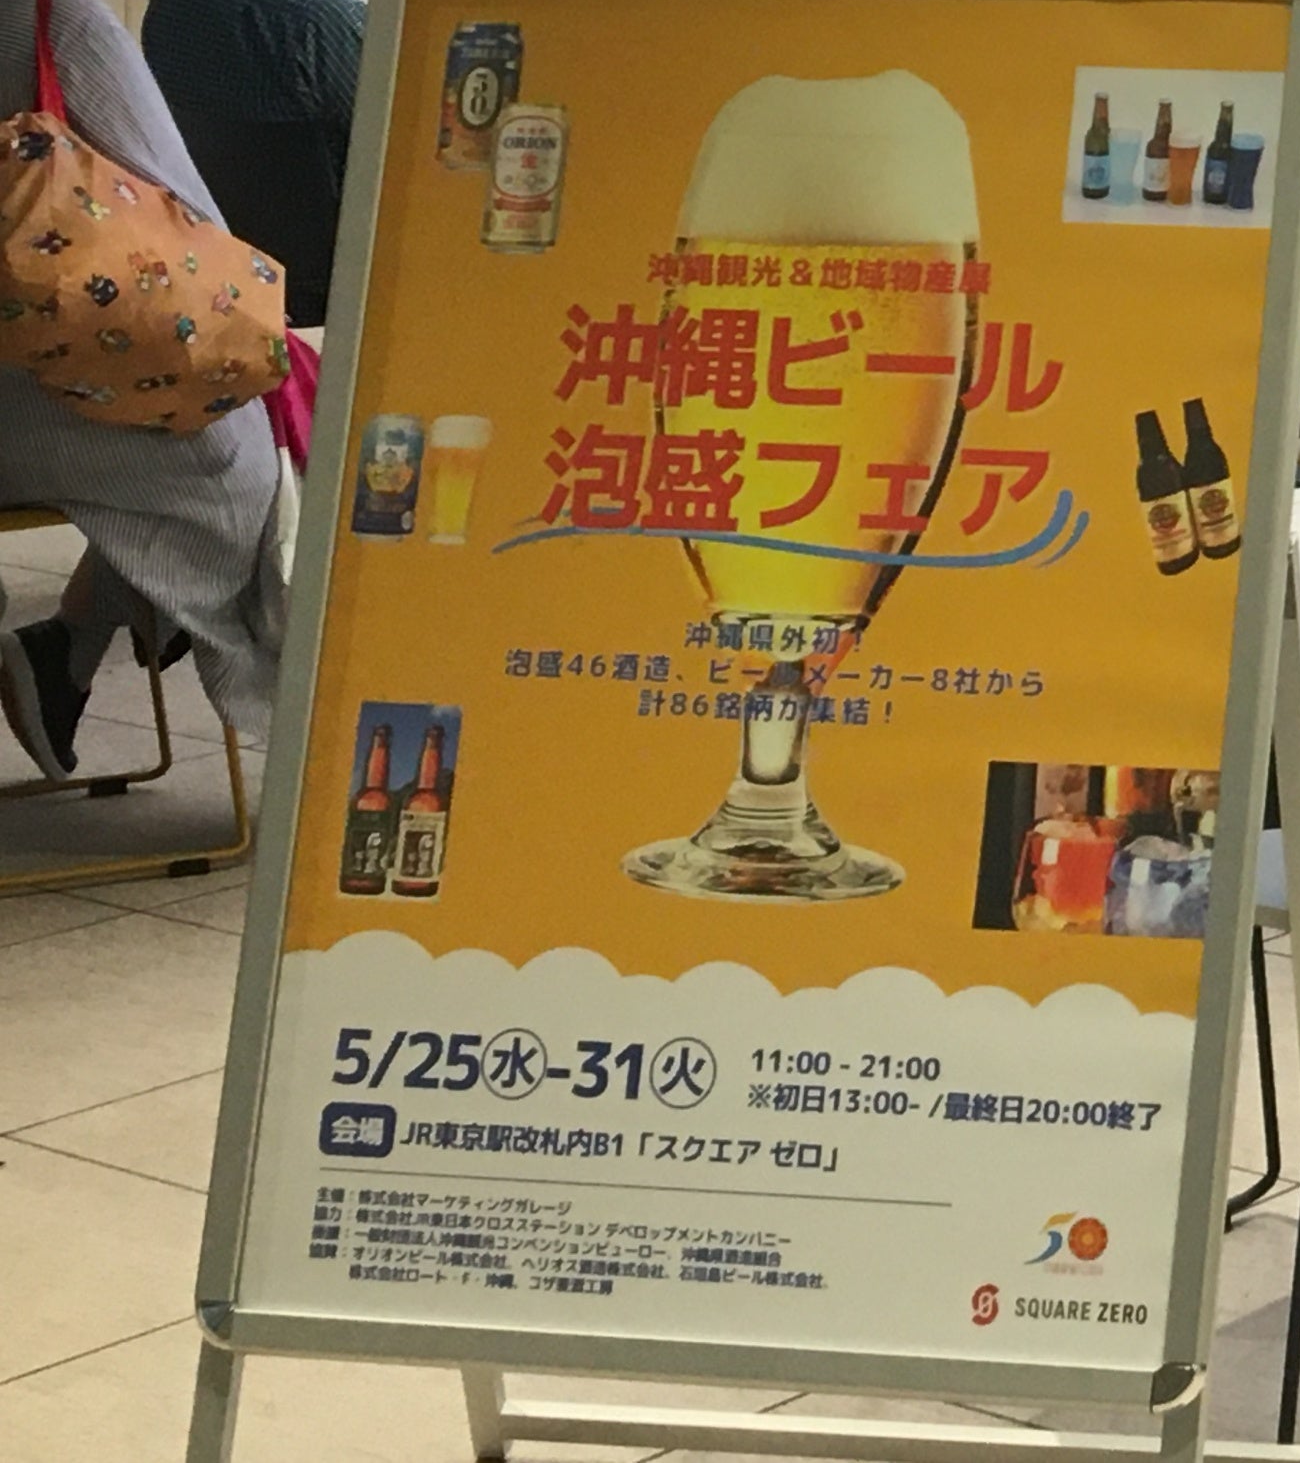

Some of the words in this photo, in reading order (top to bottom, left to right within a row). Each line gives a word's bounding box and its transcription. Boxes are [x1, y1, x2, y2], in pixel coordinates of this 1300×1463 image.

[553, 305, 1063, 413] 沖縄ビール
[540, 424, 1052, 535] 泡盛フェア
[751, 1049, 831, 1076] 11:00
[860, 1054, 940, 1080] 21:00
[331, 1117, 384, 1147] 会場
[1015, 1297, 1091, 1321] SQUARE
[1097, 1302, 1148, 1325] ZERO
